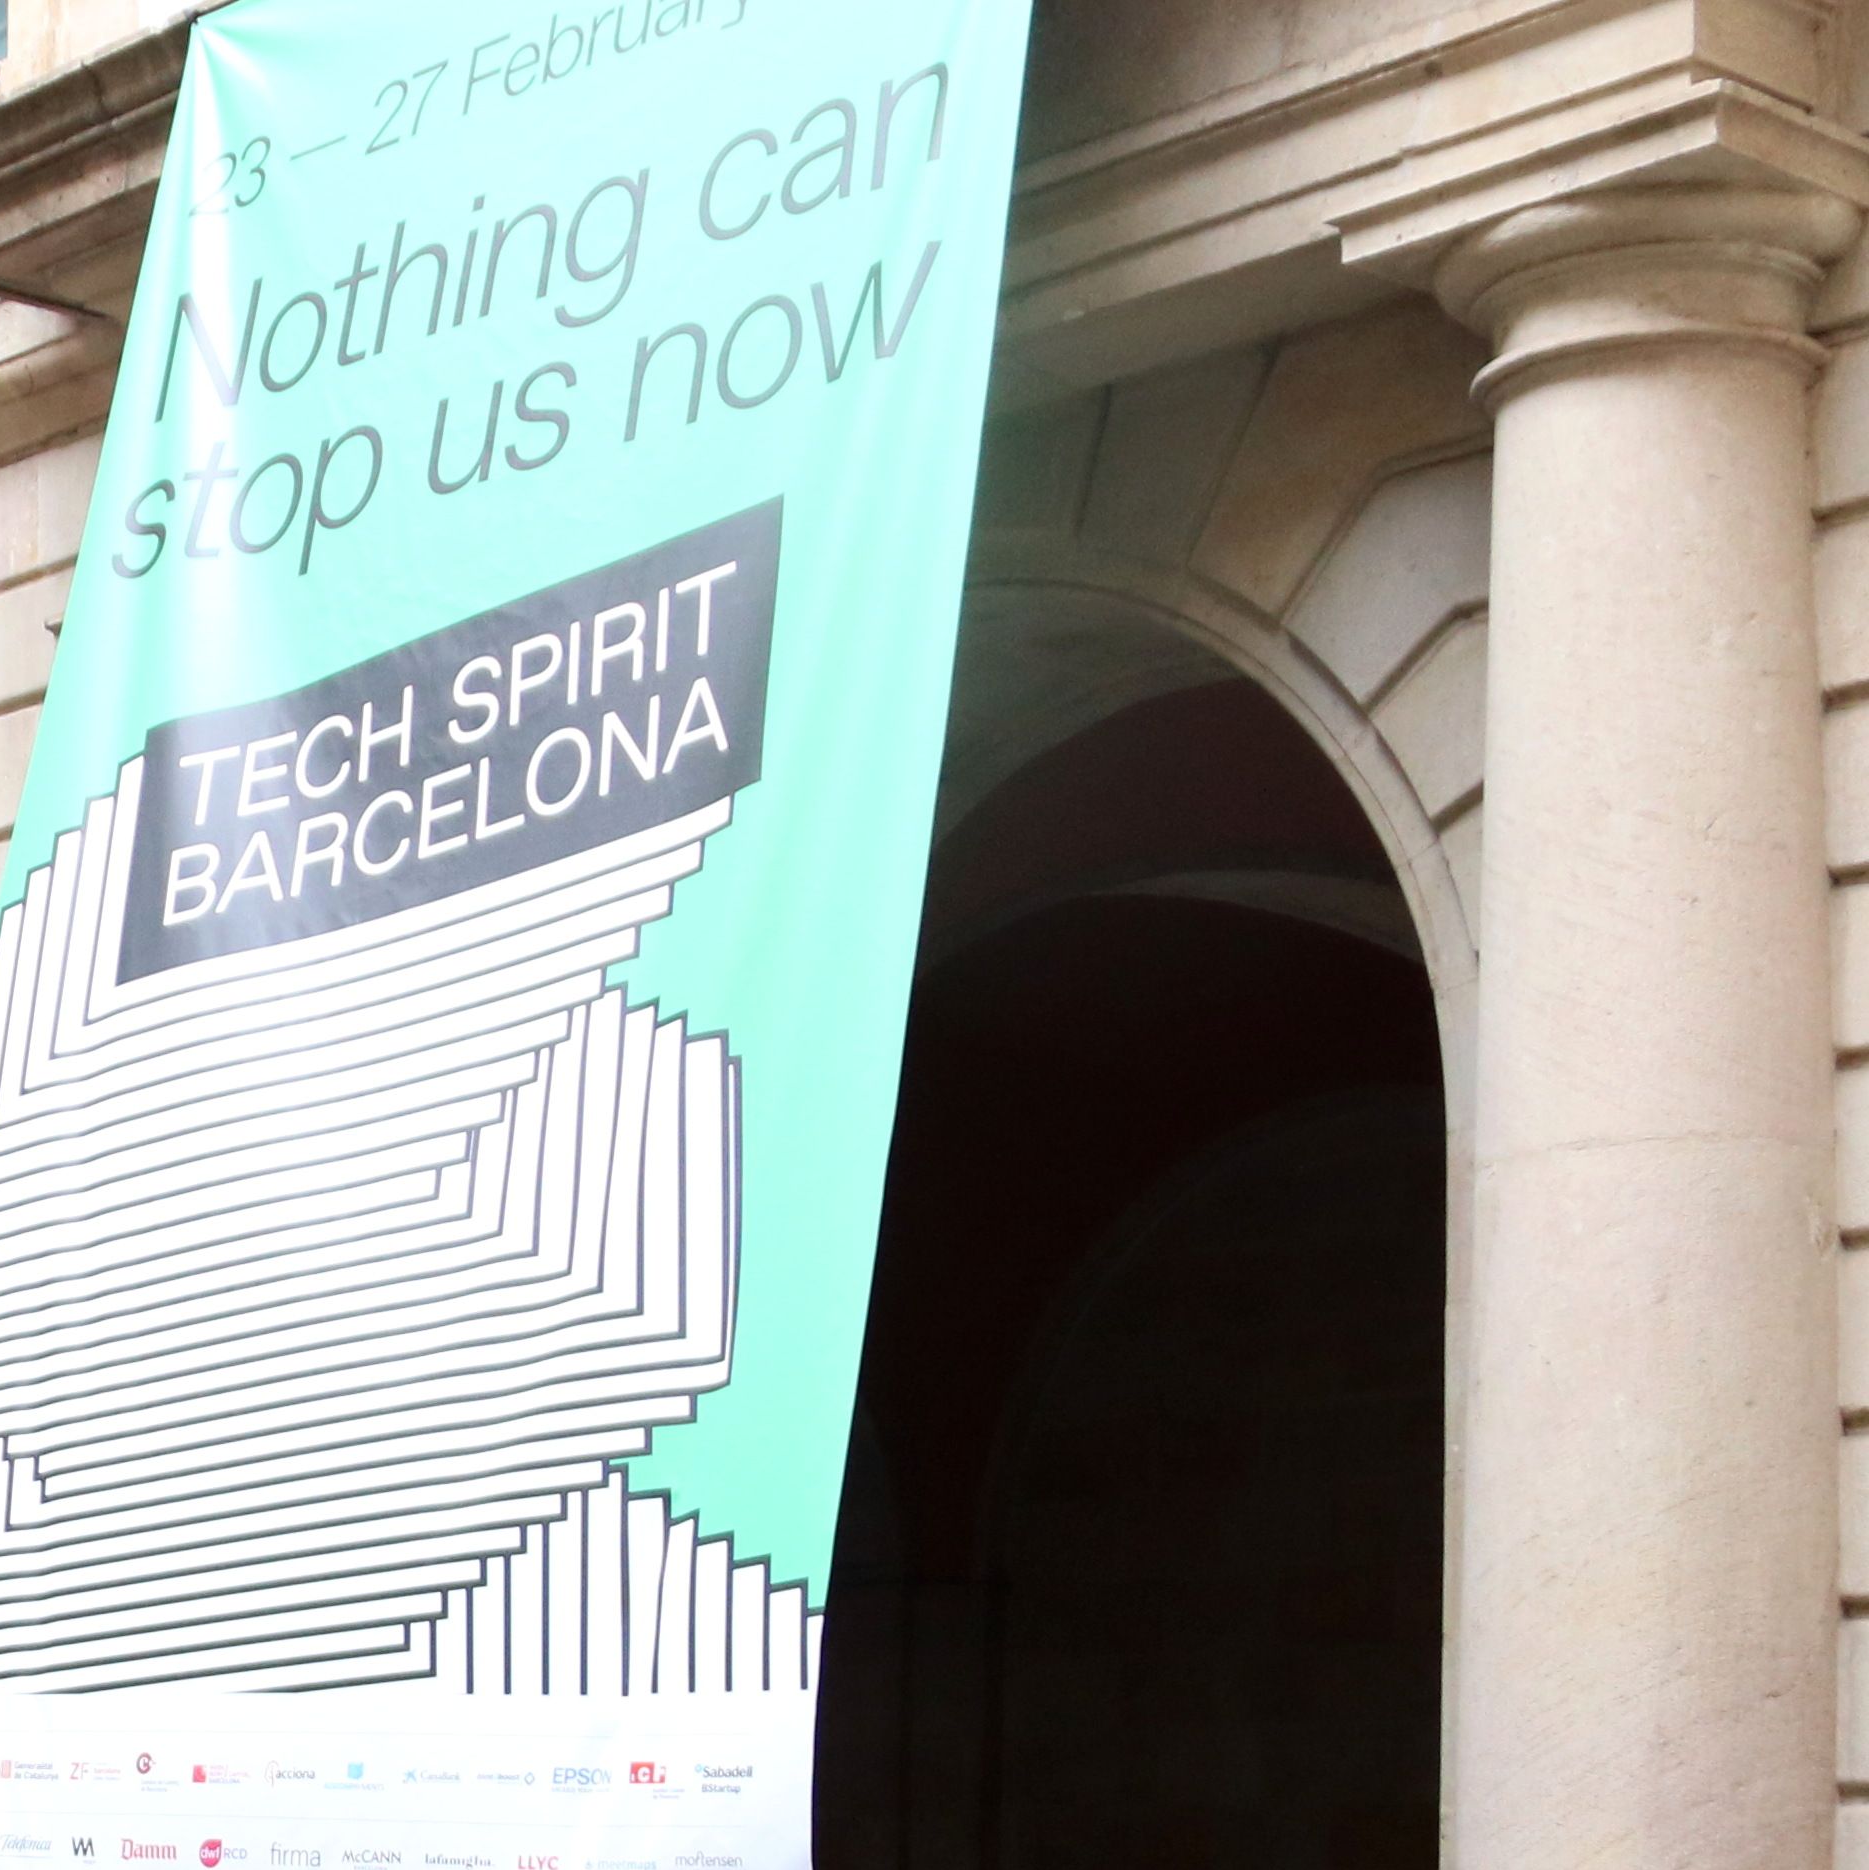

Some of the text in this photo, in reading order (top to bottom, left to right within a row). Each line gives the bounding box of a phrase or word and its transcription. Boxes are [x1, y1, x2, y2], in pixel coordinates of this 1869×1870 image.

[189, 136, 270, 217] 23
[365, 59, 448, 156] 27
[462, 0, 745, 116] Februa
[153, 59, 951, 424] Nothing can
[110, 239, 943, 579] stop us now
[178, 560, 739, 827] TECH SPIRIT
[162, 676, 730, 927] BARCELONA
[275, 1767, 316, 1780] acciona
[552, 1766, 612, 1786] EPSON
[702, 1765, 754, 1779] Sabadell
[120, 1837, 178, 1861] Damm
[223, 1847, 248, 1860] RCD
[270, 1841, 321, 1867] firma
[341, 1848, 402, 1864] McCANN
[518, 1855, 559, 1870] LLYC
